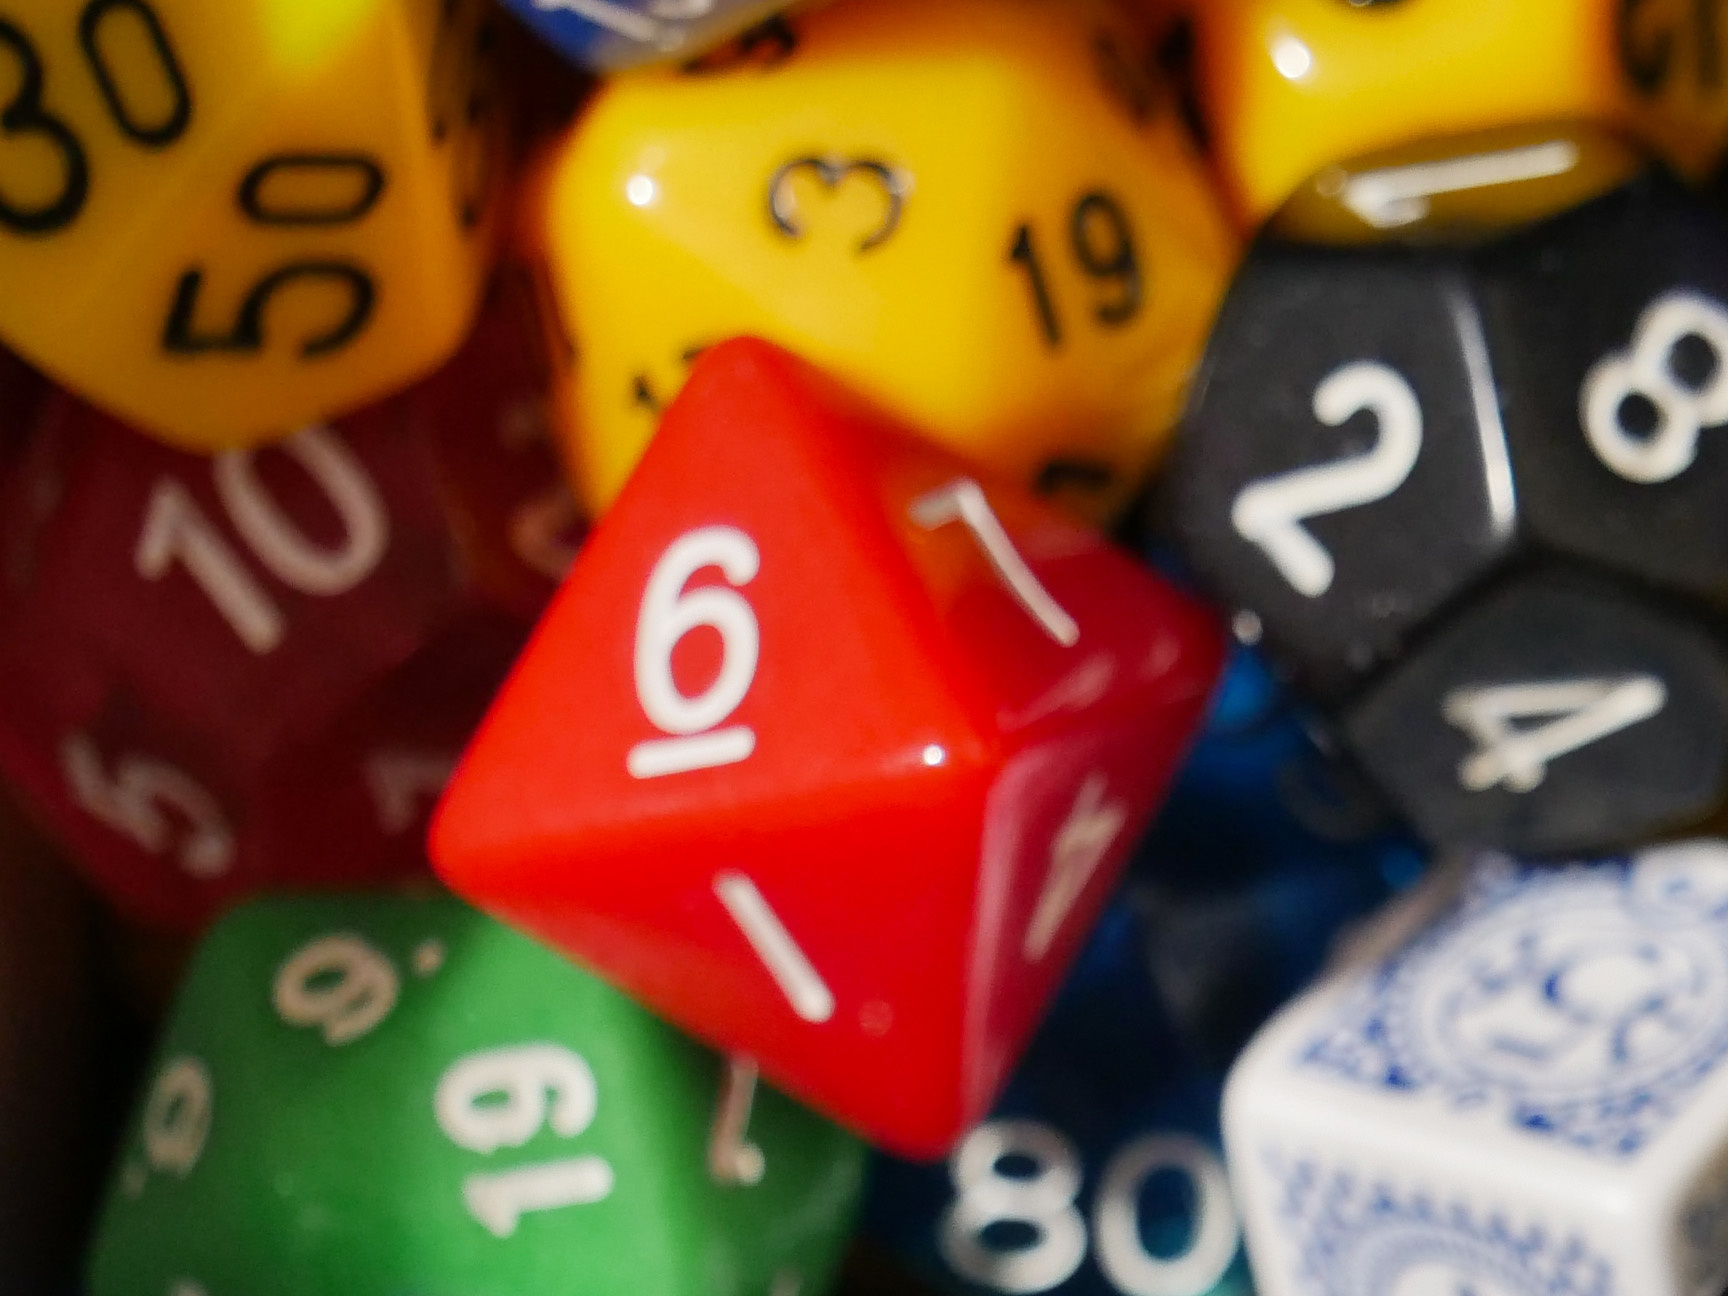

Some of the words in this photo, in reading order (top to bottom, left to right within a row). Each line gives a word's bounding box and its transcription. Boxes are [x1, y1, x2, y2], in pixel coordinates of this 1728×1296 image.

[160, 148, 386, 358] 50
[767, 155, 909, 253] 3
[1005, 186, 1146, 350] 19
[133, 420, 388, 656] 10
[1230, 358, 1423, 600] 2
[1443, 672, 1668, 792] 4
[713, 868, 836, 1024] 1
[434, 1042, 615, 1239] 19
